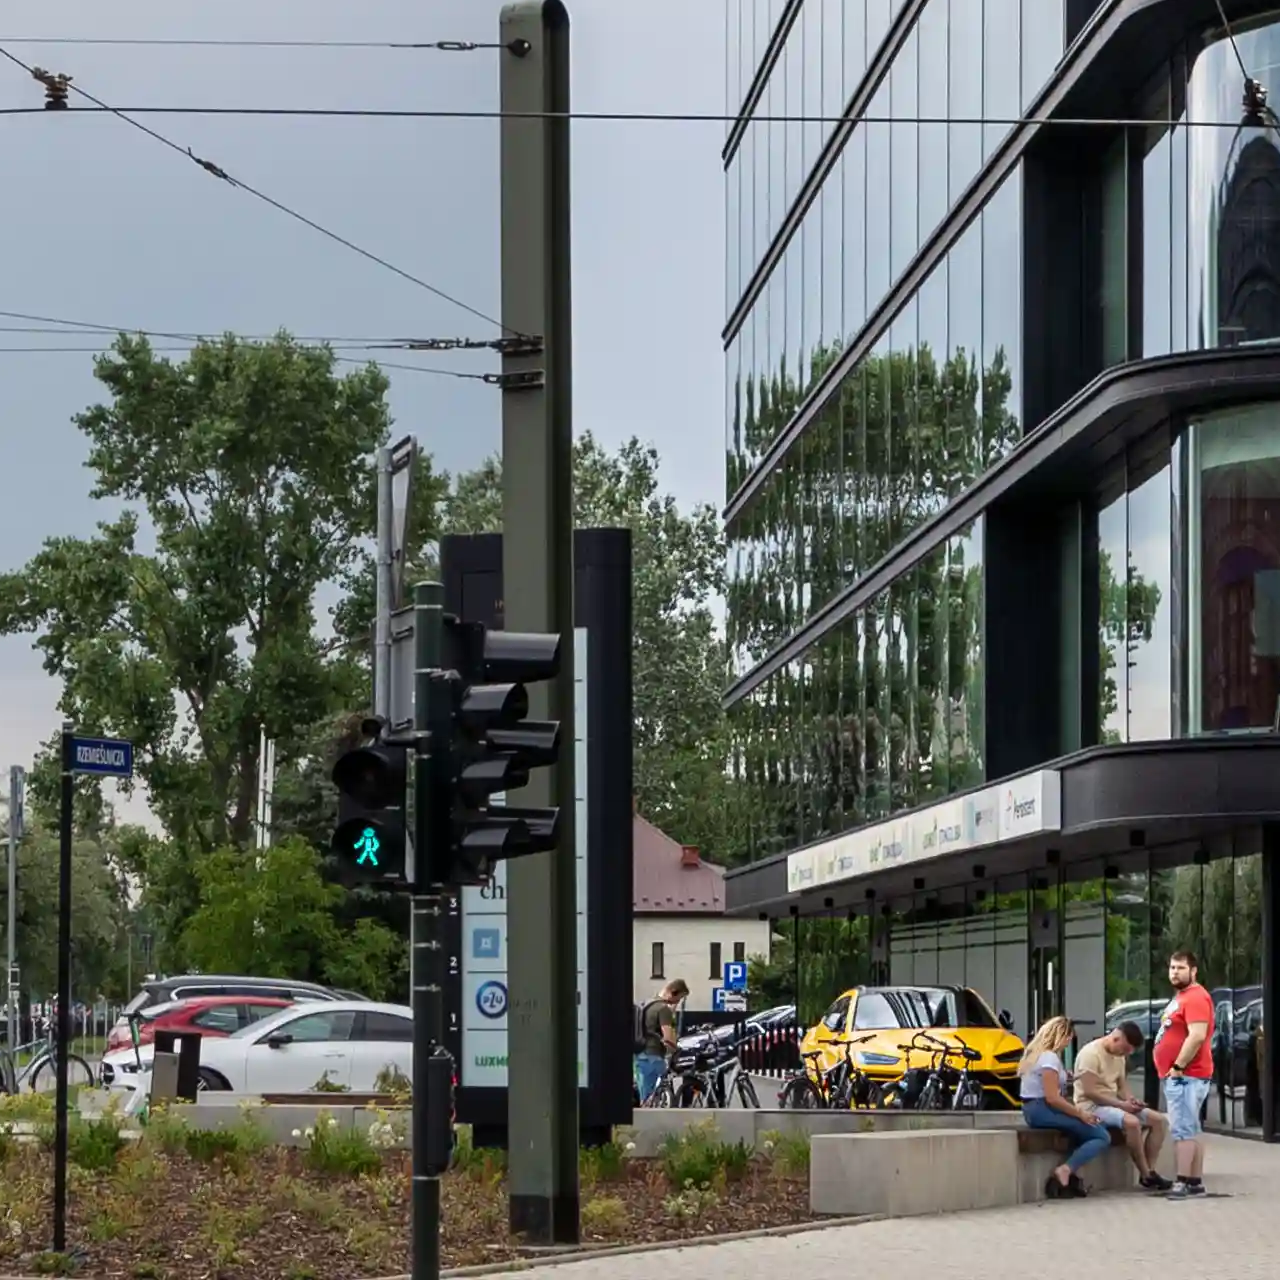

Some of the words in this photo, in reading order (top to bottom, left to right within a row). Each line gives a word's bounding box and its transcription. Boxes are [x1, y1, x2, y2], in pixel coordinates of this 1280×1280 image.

[480, 875, 508, 899] ch
[450, 898, 457, 908] 3
[450, 956, 457, 967] 2
[450, 1013, 456, 1024] 1
